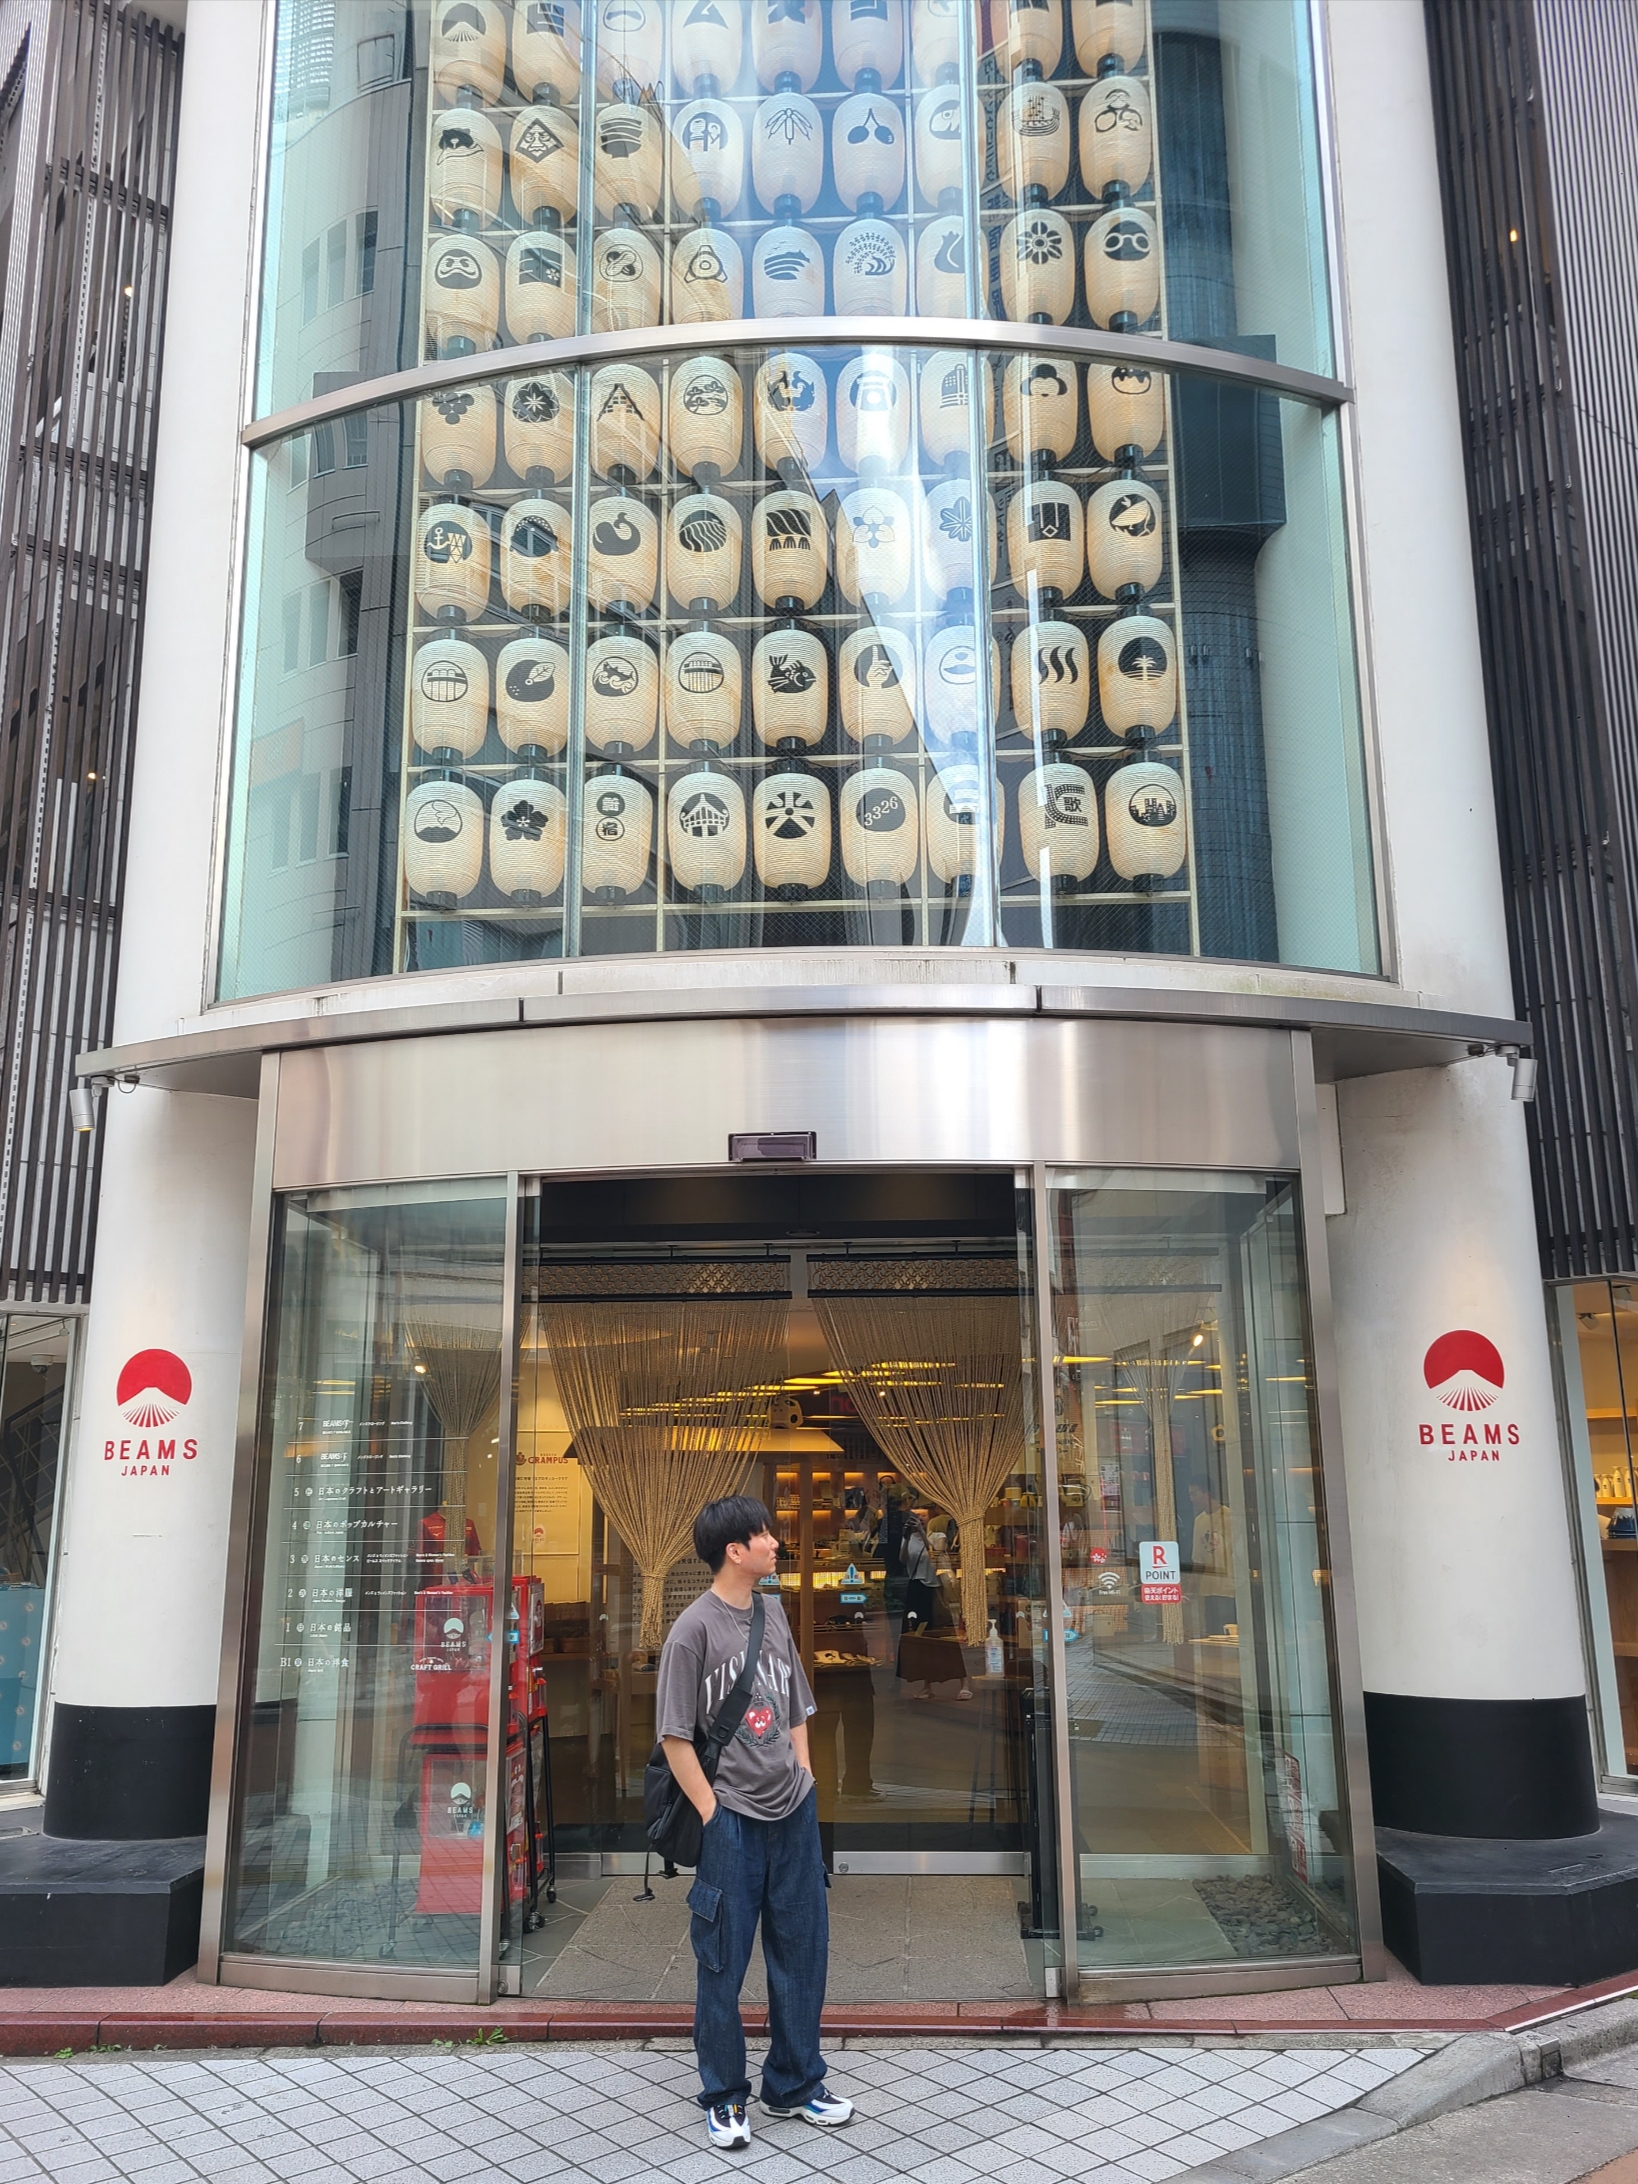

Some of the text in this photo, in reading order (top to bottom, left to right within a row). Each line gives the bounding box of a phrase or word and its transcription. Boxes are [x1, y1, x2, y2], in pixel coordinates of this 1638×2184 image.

[864, 796, 899, 826] 3326
[298, 1422, 304, 1431] 7
[1418, 1423, 1520, 1445] BEAMS
[104, 1439, 198, 1461] BEAMS
[1448, 1450, 1500, 1461] JAPAN
[121, 1465, 170, 1476] JAPAN
[292, 1520, 297, 1529] 4
[290, 1555, 295, 1564] 3
[1145, 1571, 1176, 1580] POINT
[287, 1589, 293, 1597] 2
[447, 1806, 473, 1814] BEAMS
